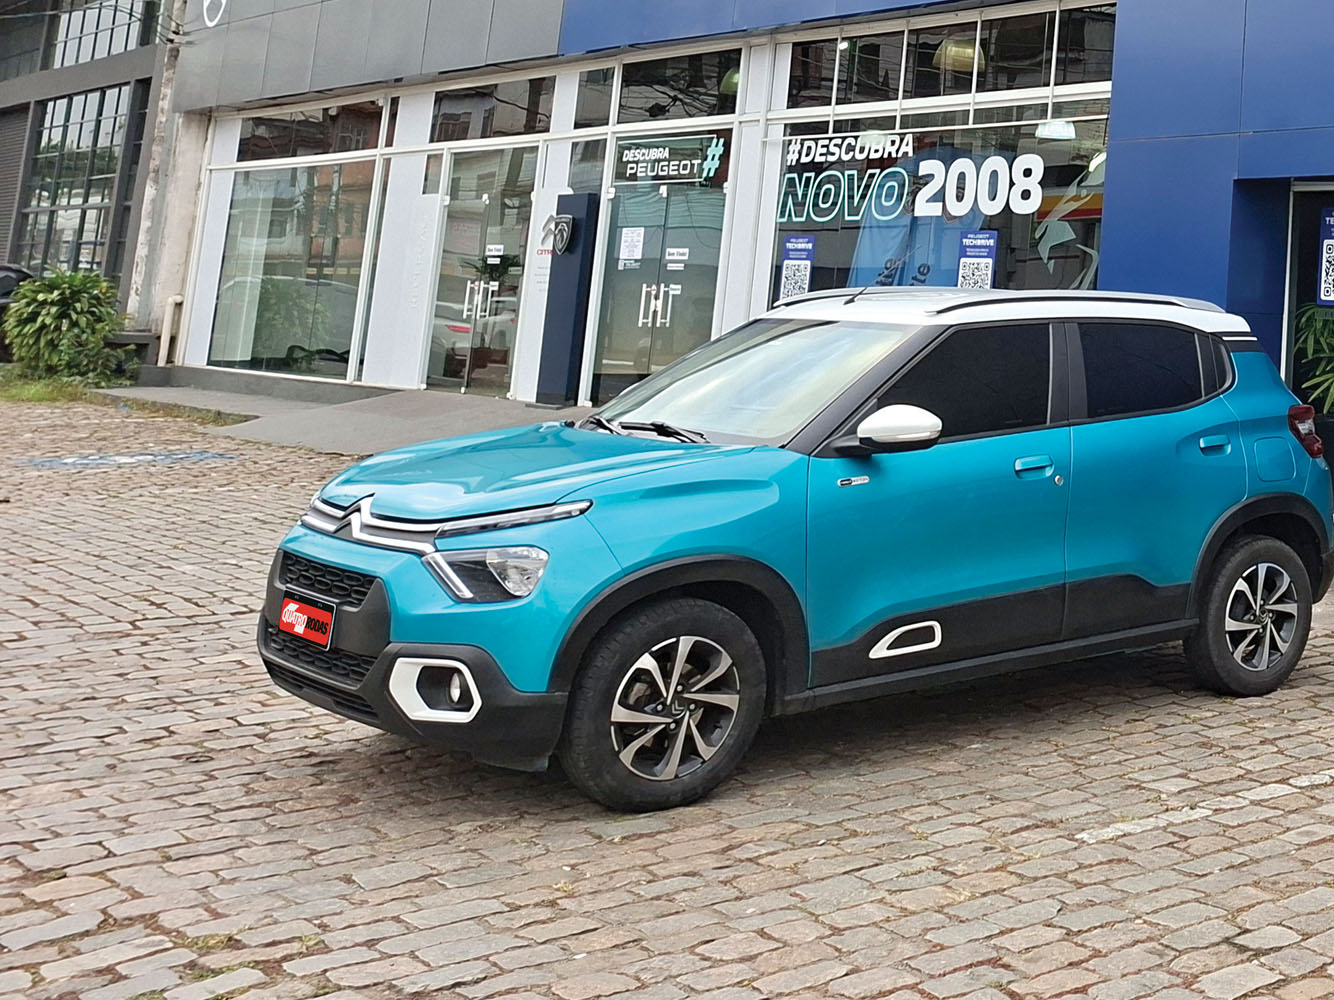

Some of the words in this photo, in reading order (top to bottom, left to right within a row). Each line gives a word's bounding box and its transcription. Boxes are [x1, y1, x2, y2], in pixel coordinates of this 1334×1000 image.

[622, 147, 669, 161] DESCUBRA
[786, 133, 914, 166] #DESCUBRA
[626, 159, 701, 177] PEUGEOT
[776, 166, 910, 223] NOVO
[914, 153, 1044, 217] 2008
[305, 616, 329, 635] RODAS
